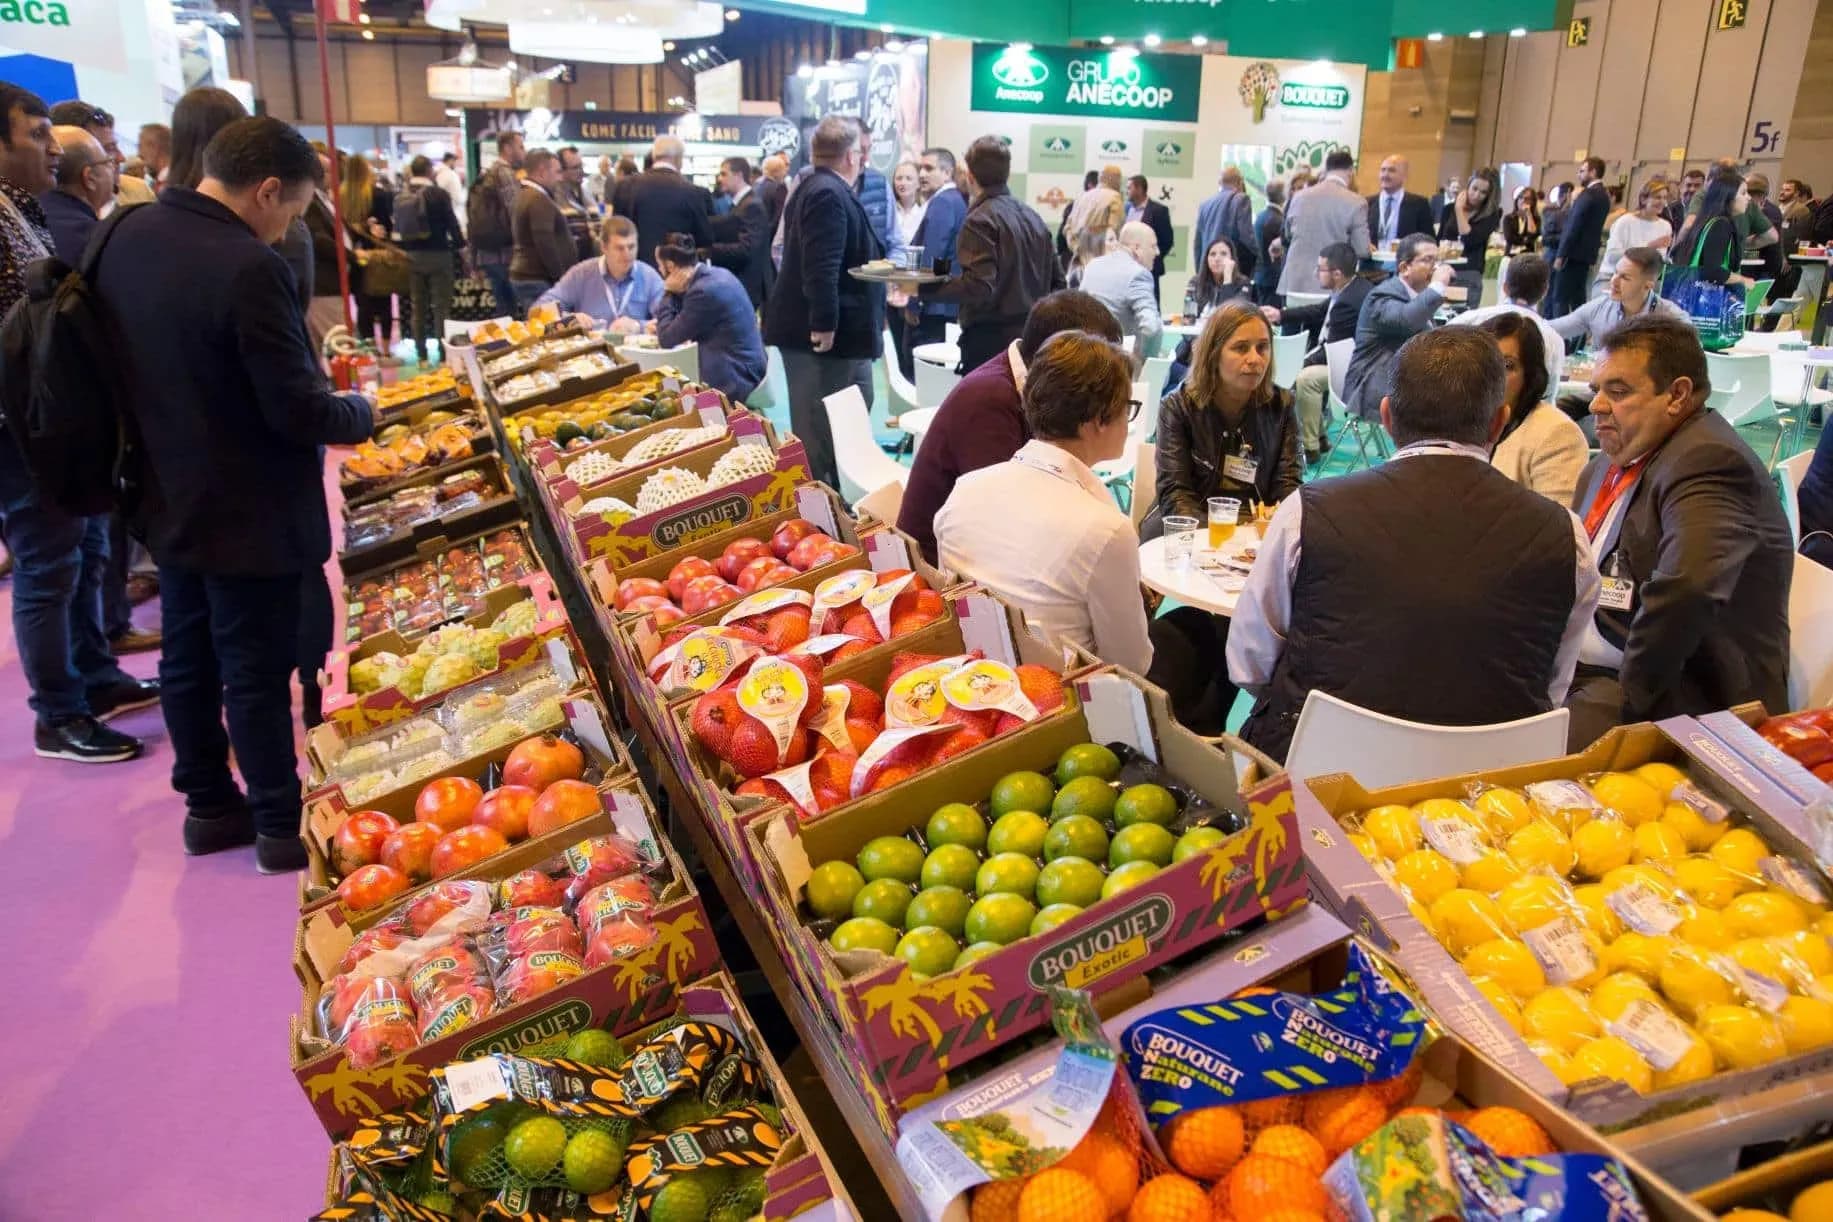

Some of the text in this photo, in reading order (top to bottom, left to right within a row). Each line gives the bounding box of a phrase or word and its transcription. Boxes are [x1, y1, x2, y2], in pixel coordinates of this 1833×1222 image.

[1067, 60, 1141, 86] GRUO
[1066, 83, 1173, 108] ANECOOP
[1283, 86, 1346, 106] BOUQUET
[662, 500, 741, 541] BOUQUET
[1041, 904, 1160, 981] BOUQUET
[1082, 949, 1131, 979] Exotic
[427, 1001, 468, 1040] OUQUET
[1291, 1008, 1382, 1061] BOUQUET
[1149, 1033, 1244, 1085] BOUQUET
[1281, 1028, 1337, 1063] ZERO
[708, 1060, 737, 1107] BOUET
[956, 1073, 1024, 1113] BOUQUET
[1140, 1064, 1192, 1089] ZERO
